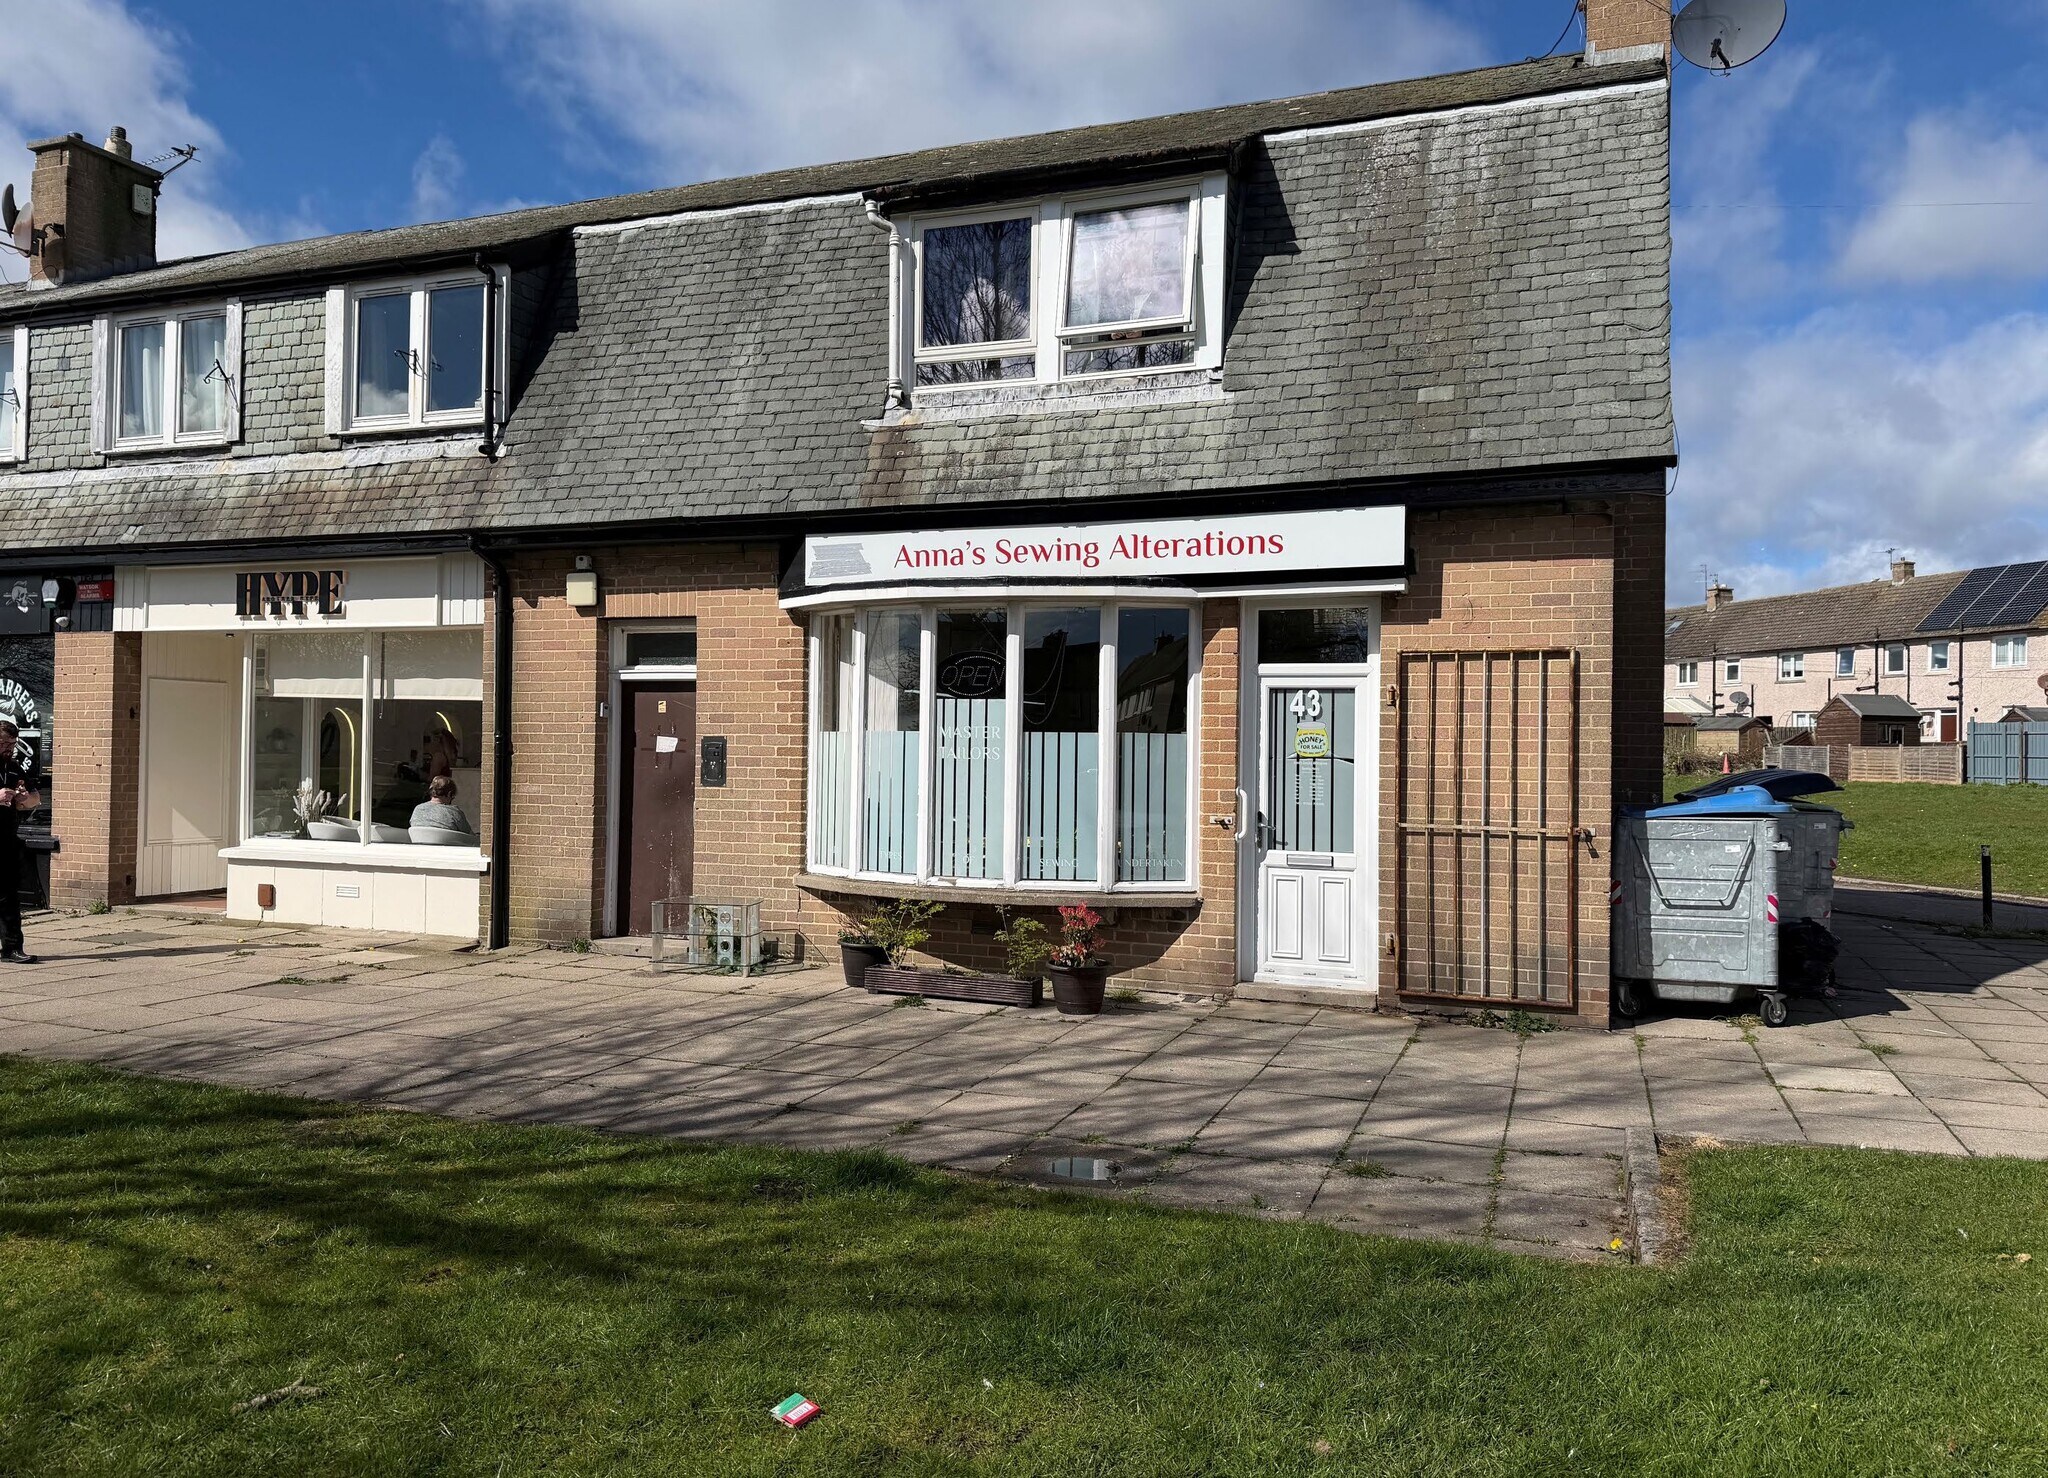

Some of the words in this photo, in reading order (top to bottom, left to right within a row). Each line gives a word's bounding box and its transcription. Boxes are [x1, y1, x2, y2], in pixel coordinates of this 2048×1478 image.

[894, 541, 986, 568] Anna's
[995, 538, 1100, 568] Sewing
[1109, 531, 1284, 560] Alterations
[235, 570, 343, 616] HYPE
[941, 665, 1006, 686] OPEN
[1290, 689, 1321, 717] 43
[940, 725, 1001, 739] MASTER
[1299, 736, 1324, 745] HONEY
[939, 746, 1000, 760] TAILORS
[1039, 858, 1079, 867] SEWING
